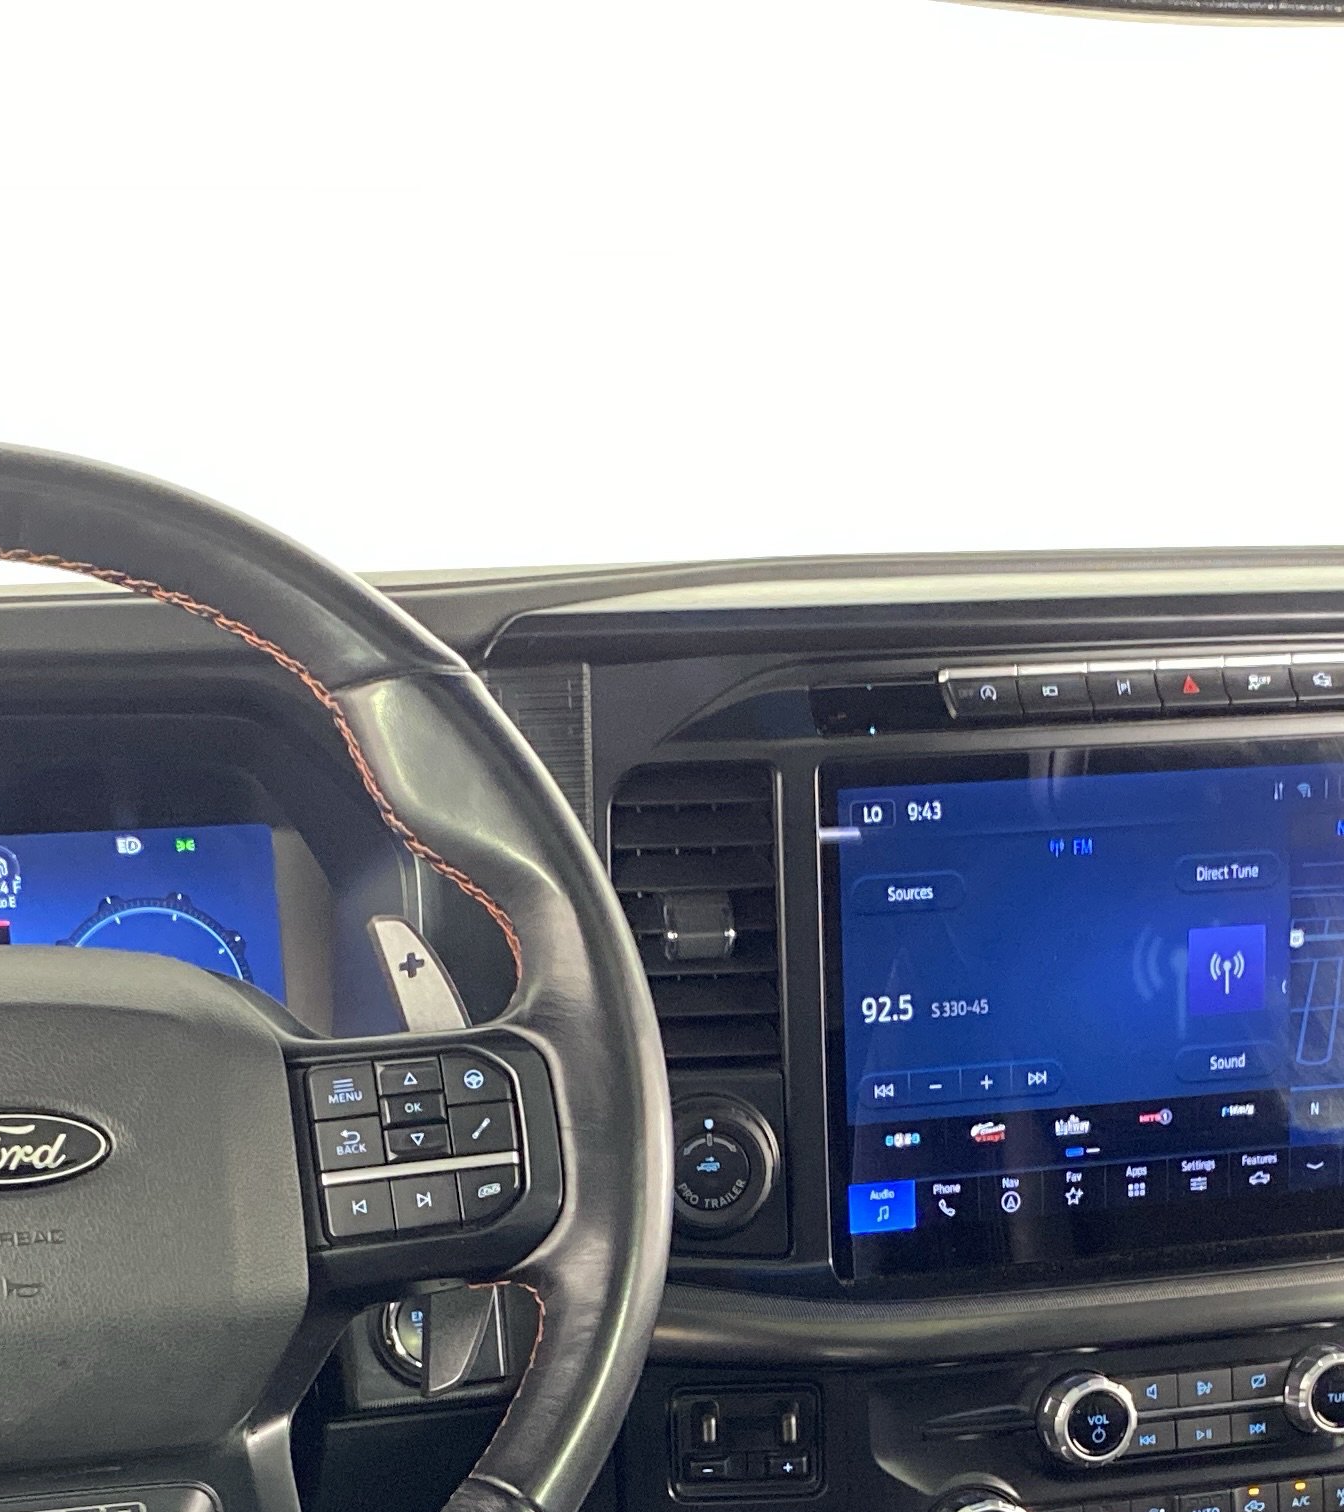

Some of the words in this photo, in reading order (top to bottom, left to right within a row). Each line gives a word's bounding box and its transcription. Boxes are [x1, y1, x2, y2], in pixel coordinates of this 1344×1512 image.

[863, 805, 882, 823] LO
[908, 801, 942, 821] 9:43
[1073, 839, 1093, 855] FM
[1196, 865, 1229, 882] Direct
[1231, 864, 1259, 879] Tune
[887, 886, 934, 902] Sources
[861, 994, 913, 1024] 92.5
[1210, 1052, 1246, 1071] Sound
[328, 1091, 363, 1104] MENU
[404, 1103, 423, 1113] OK
[1310, 1102, 1320, 1116] N
[336, 1143, 367, 1156] BACK
[1181, 1159, 1216, 1173] Settings
[1241, 1153, 1278, 1167] Features
[1066, 1171, 1082, 1183] Fav
[1126, 1166, 1148, 1178] Apps
[932, 1183, 961, 1195] Phone
[1002, 1177, 1019, 1189] Nav
[677, 1182, 699, 1205] PRO
[704, 1178, 746, 1209] TRAILER
[869, 1189, 895, 1201] Audio
[1087, 1414, 1110, 1426] VOL
[1291, 1495, 1311, 1507] A/C
